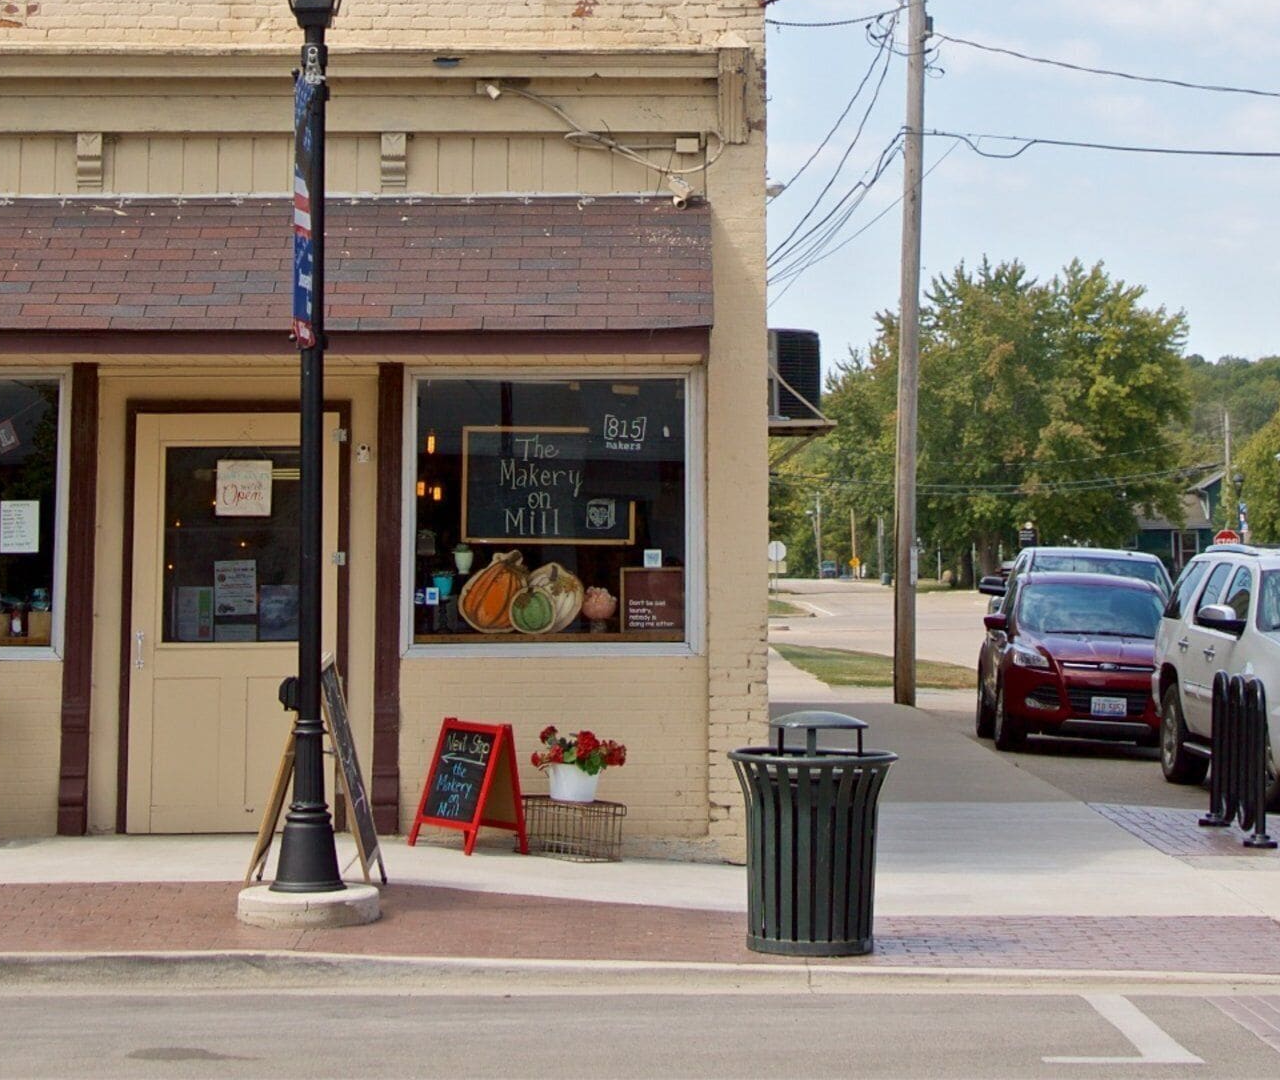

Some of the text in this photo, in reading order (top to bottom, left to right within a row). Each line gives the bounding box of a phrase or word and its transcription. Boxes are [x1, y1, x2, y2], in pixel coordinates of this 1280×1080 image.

[515, 434, 560, 461] The
[606, 441, 641, 451] makers
[499, 459, 583, 498] Makery
[527, 491, 551, 509] on
[504, 508, 560, 535] Mill
[447, 733, 490, 762] Next Stop
[436, 774, 473, 799] Makery
[436, 801, 461, 817] Mill
